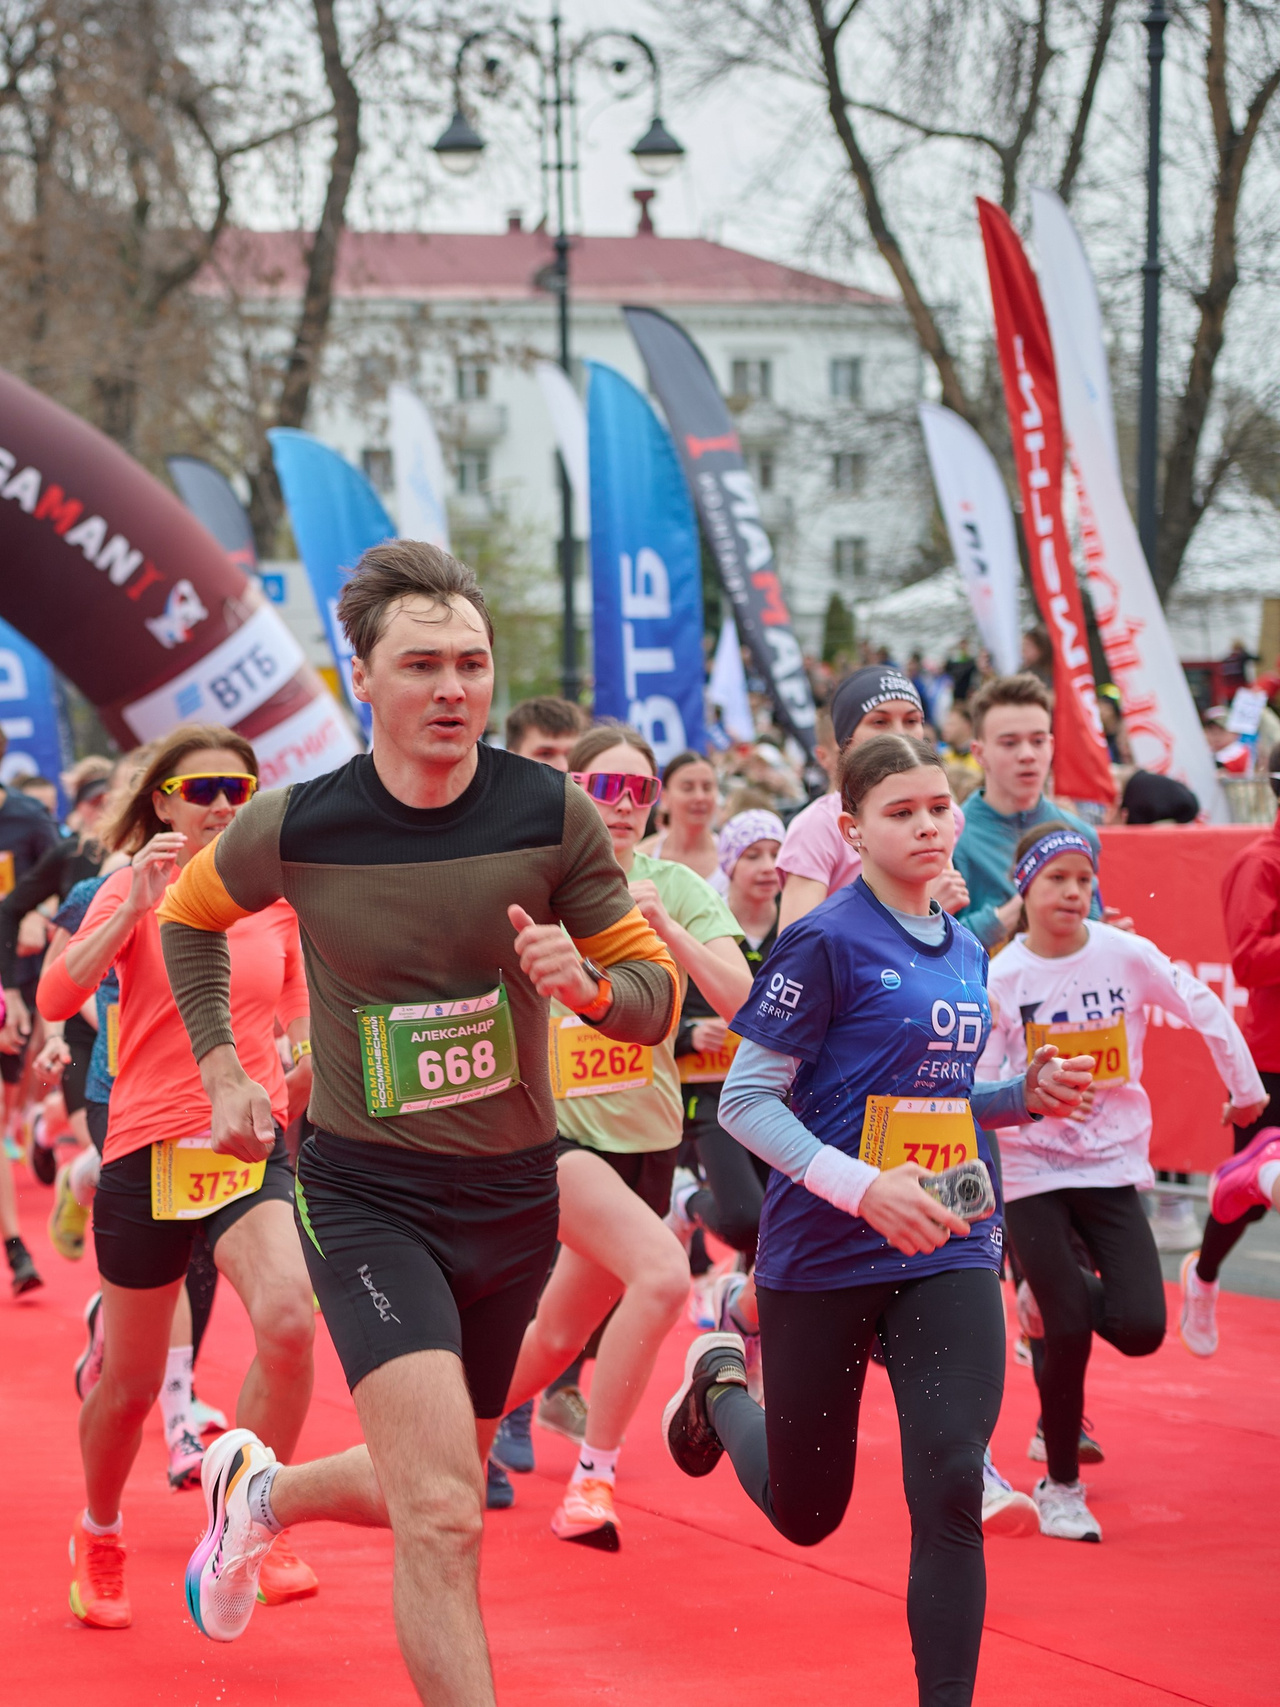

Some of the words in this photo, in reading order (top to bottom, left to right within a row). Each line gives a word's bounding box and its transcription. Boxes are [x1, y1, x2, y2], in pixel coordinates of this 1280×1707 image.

[209, 643, 278, 710] ВТБ
[621, 546, 688, 767] ВТБ
[410, 1018, 496, 1043] АЛЕКСАНДР
[759, 1000, 793, 1022] FERRIT
[361, 1016, 380, 1109] САМАРСКИЙ
[369, 1015, 388, 1109] КОСМИЧЕСКИЙ
[378, 1015, 395, 1108] ПОЛУМАРАФОН
[570, 1043, 644, 1081] 3262
[577, 1032, 606, 1043] КРИС
[417, 1039, 497, 1091] 668
[863, 1104, 877, 1164] АРСКИЙ
[903, 1143, 967, 1174] 3712
[188, 1168, 251, 1203] 3731
